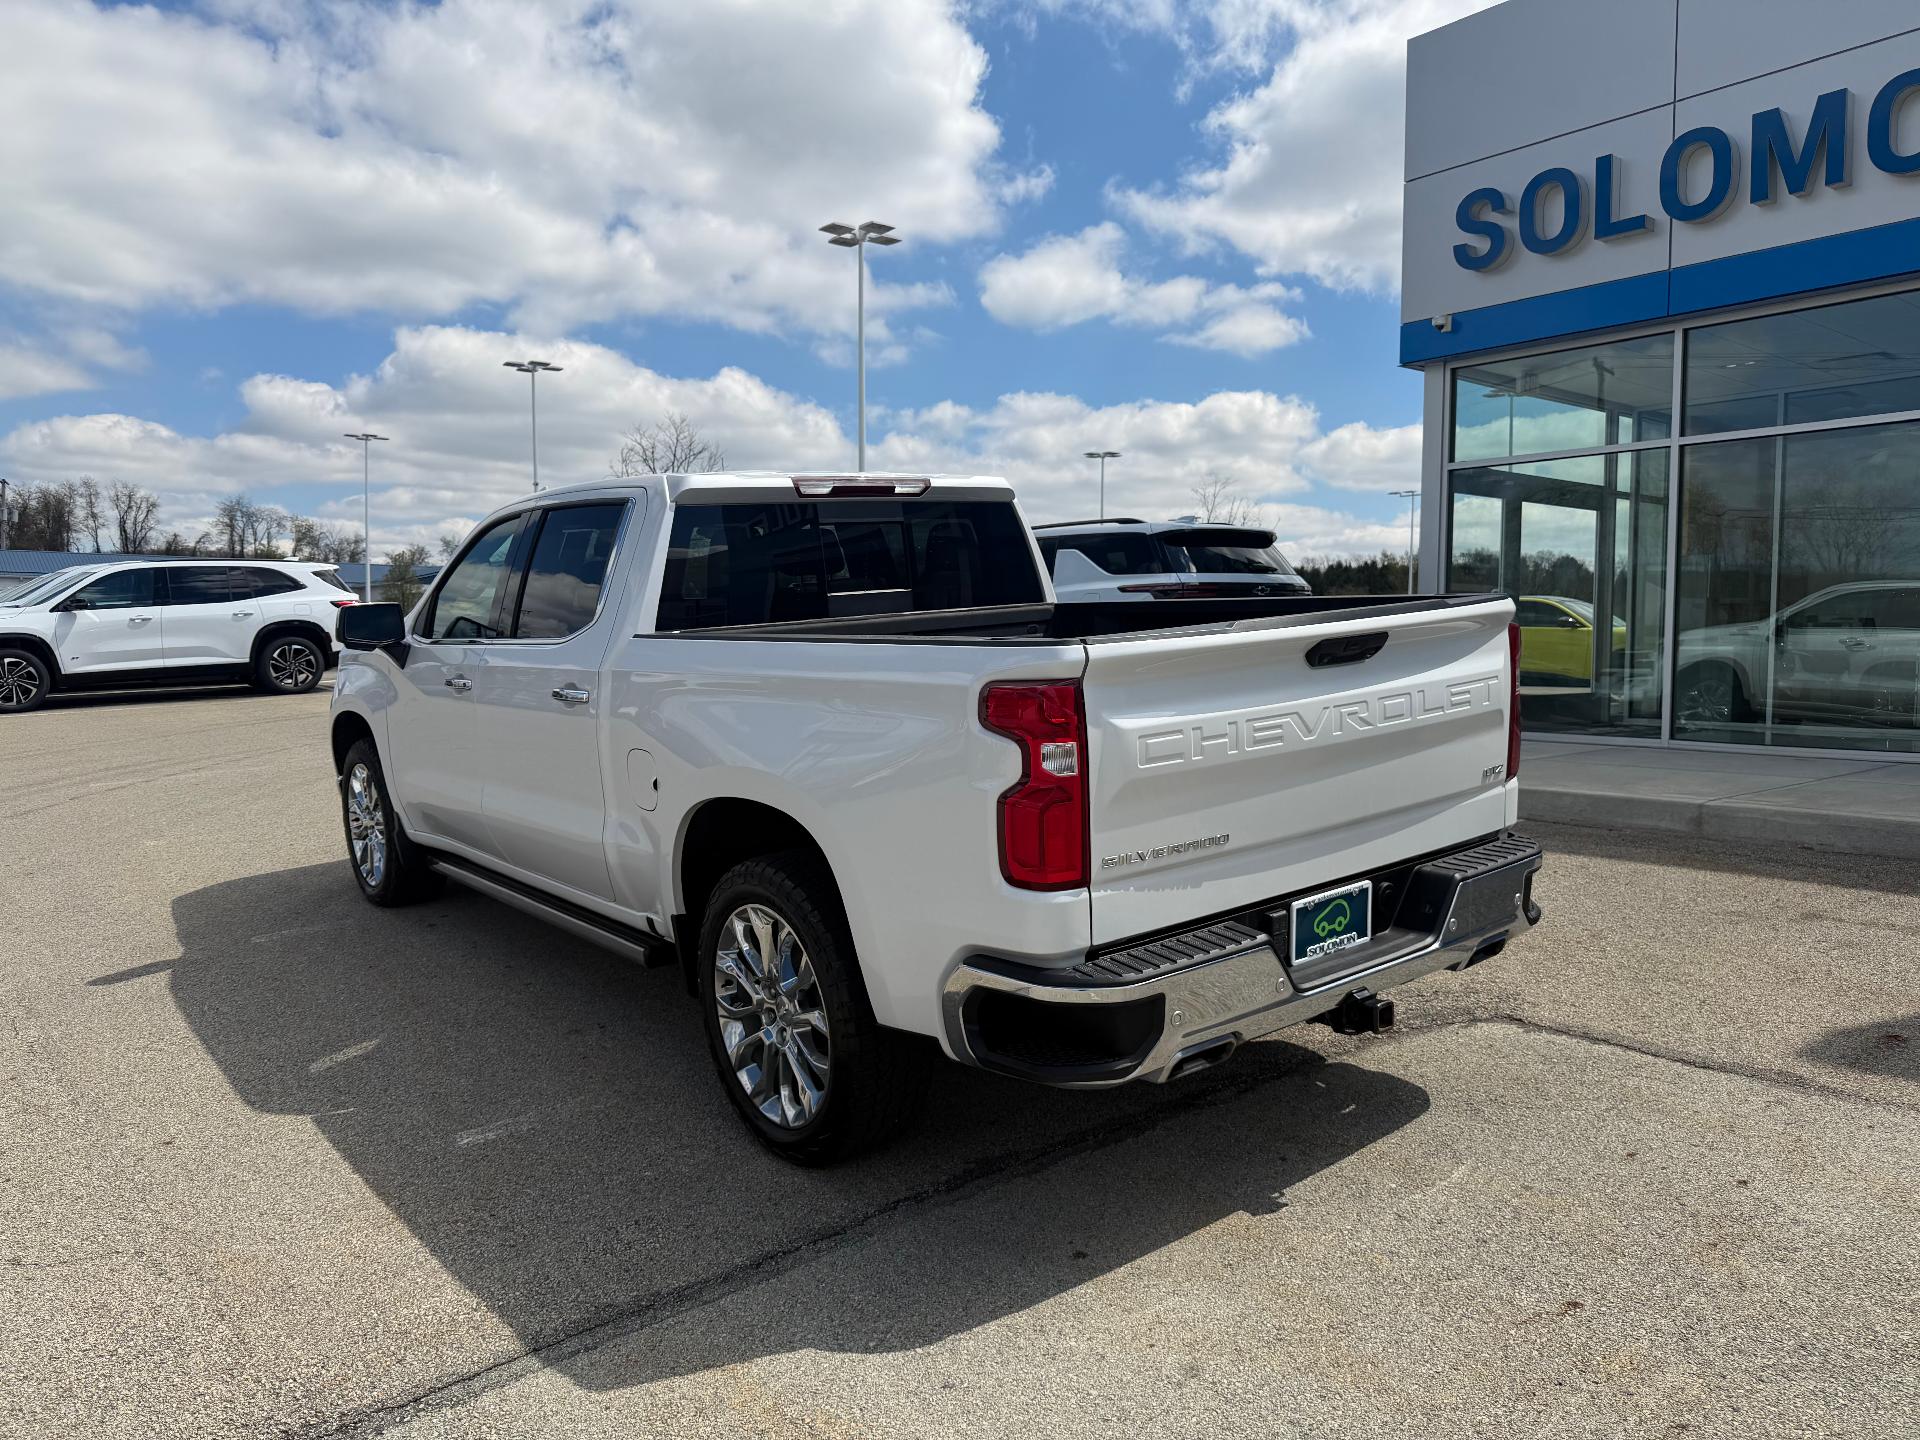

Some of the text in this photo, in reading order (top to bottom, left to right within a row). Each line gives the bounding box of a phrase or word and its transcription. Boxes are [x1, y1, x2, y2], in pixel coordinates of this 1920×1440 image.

[1137, 675, 1499, 769] CHEVROLET
[1482, 764, 1504, 777] LTZ
[1102, 834, 1230, 869] SILVERADO
[1308, 933, 1357, 957] SOLOMON
